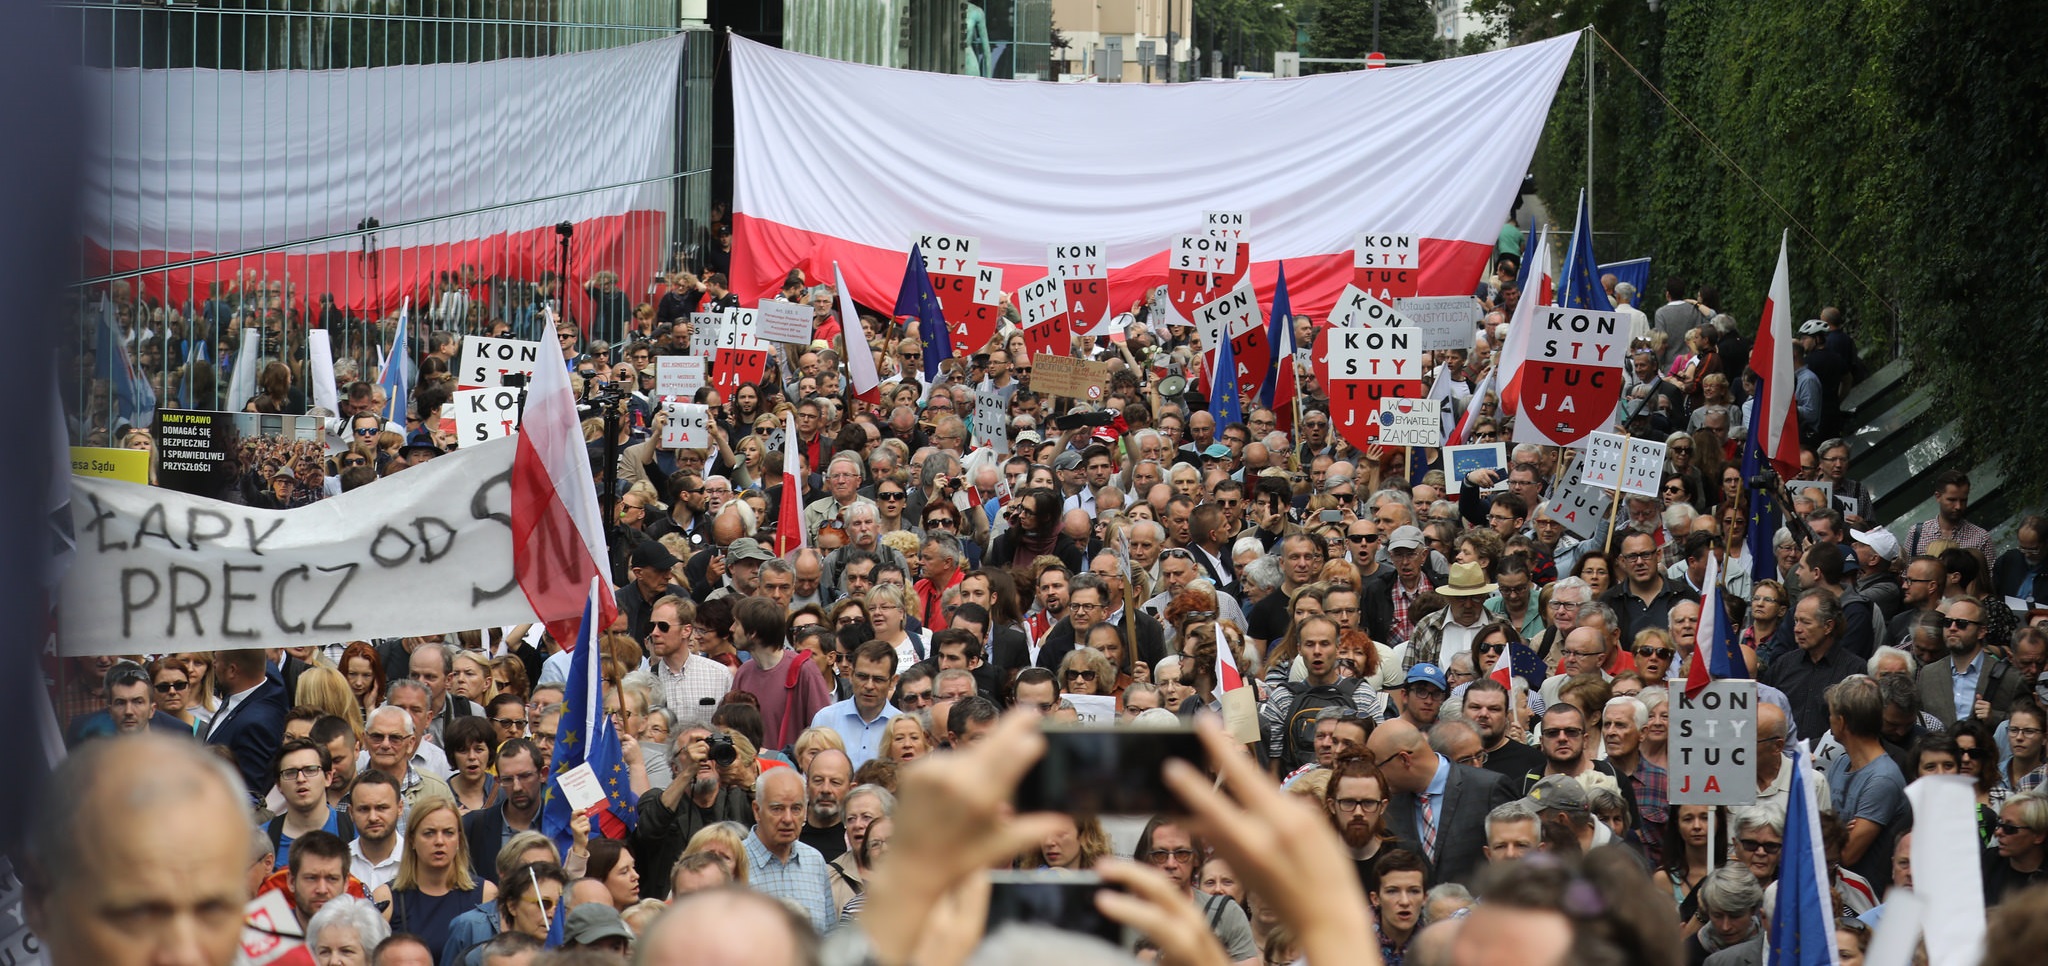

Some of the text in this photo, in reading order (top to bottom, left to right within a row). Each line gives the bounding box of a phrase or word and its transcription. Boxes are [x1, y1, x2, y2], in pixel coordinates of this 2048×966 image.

[1209, 214, 1242, 224] KON
[1210, 229, 1241, 238] STY
[921, 235, 969, 252] KON
[1182, 237, 1227, 252] KON
[1365, 236, 1409, 248] KON
[1056, 245, 1096, 258] KON
[1181, 255, 1225, 270] STY
[1366, 254, 1408, 265] STY
[1058, 264, 1096, 276] STY
[1365, 270, 1407, 283] TUC
[934, 276, 963, 291] UC
[1181, 273, 1222, 287] TUC
[1025, 278, 1057, 302] KON
[1072, 281, 1097, 294] UC
[1177, 291, 1204, 304] JA
[1028, 298, 1058, 323] STY
[1204, 291, 1247, 323] KON
[1351, 293, 1402, 328] KON
[1400, 301, 1471, 311] Ustawa sprzeczna
[694, 316, 721, 325] KON
[730, 313, 752, 325] KO
[1547, 312, 1615, 335] KON
[1031, 319, 1062, 342] TUC
[1437, 327, 1450, 335] ma
[1231, 333, 1257, 356] UC
[1345, 333, 1408, 349] KON
[1433, 338, 1465, 348] prawnej
[477, 342, 537, 362] KON
[1544, 340, 1611, 362] STY
[724, 352, 756, 367] TUC
[1345, 358, 1406, 375] STY
[718, 372, 740, 387] JA
[1542, 366, 1605, 388] TUC
[1345, 384, 1405, 400] TUC
[471, 391, 514, 413] KO
[668, 404, 703, 413] STY
[978, 396, 1003, 409] KON
[1534, 393, 1575, 413] JA
[162, 414, 211, 424] MAMY PRAWO
[978, 409, 1003, 421] STY
[1344, 409, 1380, 426] JA
[668, 418, 703, 428] TUC
[978, 423, 1002, 436] TUC
[162, 425, 211, 438] DOMAGAĆ SIĘ
[475, 420, 513, 441] ST
[1382, 429, 1437, 445] ZAMOŚĆ
[163, 438, 210, 448] BEZPIECZNEJ
[667, 433, 689, 442] JA
[1593, 437, 1622, 450] KON
[163, 450, 225, 461] I SPRAWIEDLIWEJ
[1592, 448, 1619, 460] STY
[1632, 444, 1661, 456] KON
[91, 460, 115, 473] Sądu
[163, 461, 211, 472] PRZYSZŁOŚCI
[1590, 459, 1617, 471] TUC
[1630, 455, 1659, 467] STY
[1587, 471, 1604, 480] JA
[1629, 466, 1656, 479] TUC
[1625, 478, 1643, 488] JA
[1562, 488, 1599, 516] TUC
[1552, 503, 1576, 523] JA
[82, 492, 285, 556] ŁAPY
[369, 516, 458, 568] OD
[120, 562, 360, 639] PRECZ
[1679, 691, 1747, 710] KON
[1077, 713, 1096, 722] ON
[1680, 719, 1748, 738] STY
[1681, 747, 1745, 765] TUC
[1680, 775, 1720, 793] JA
